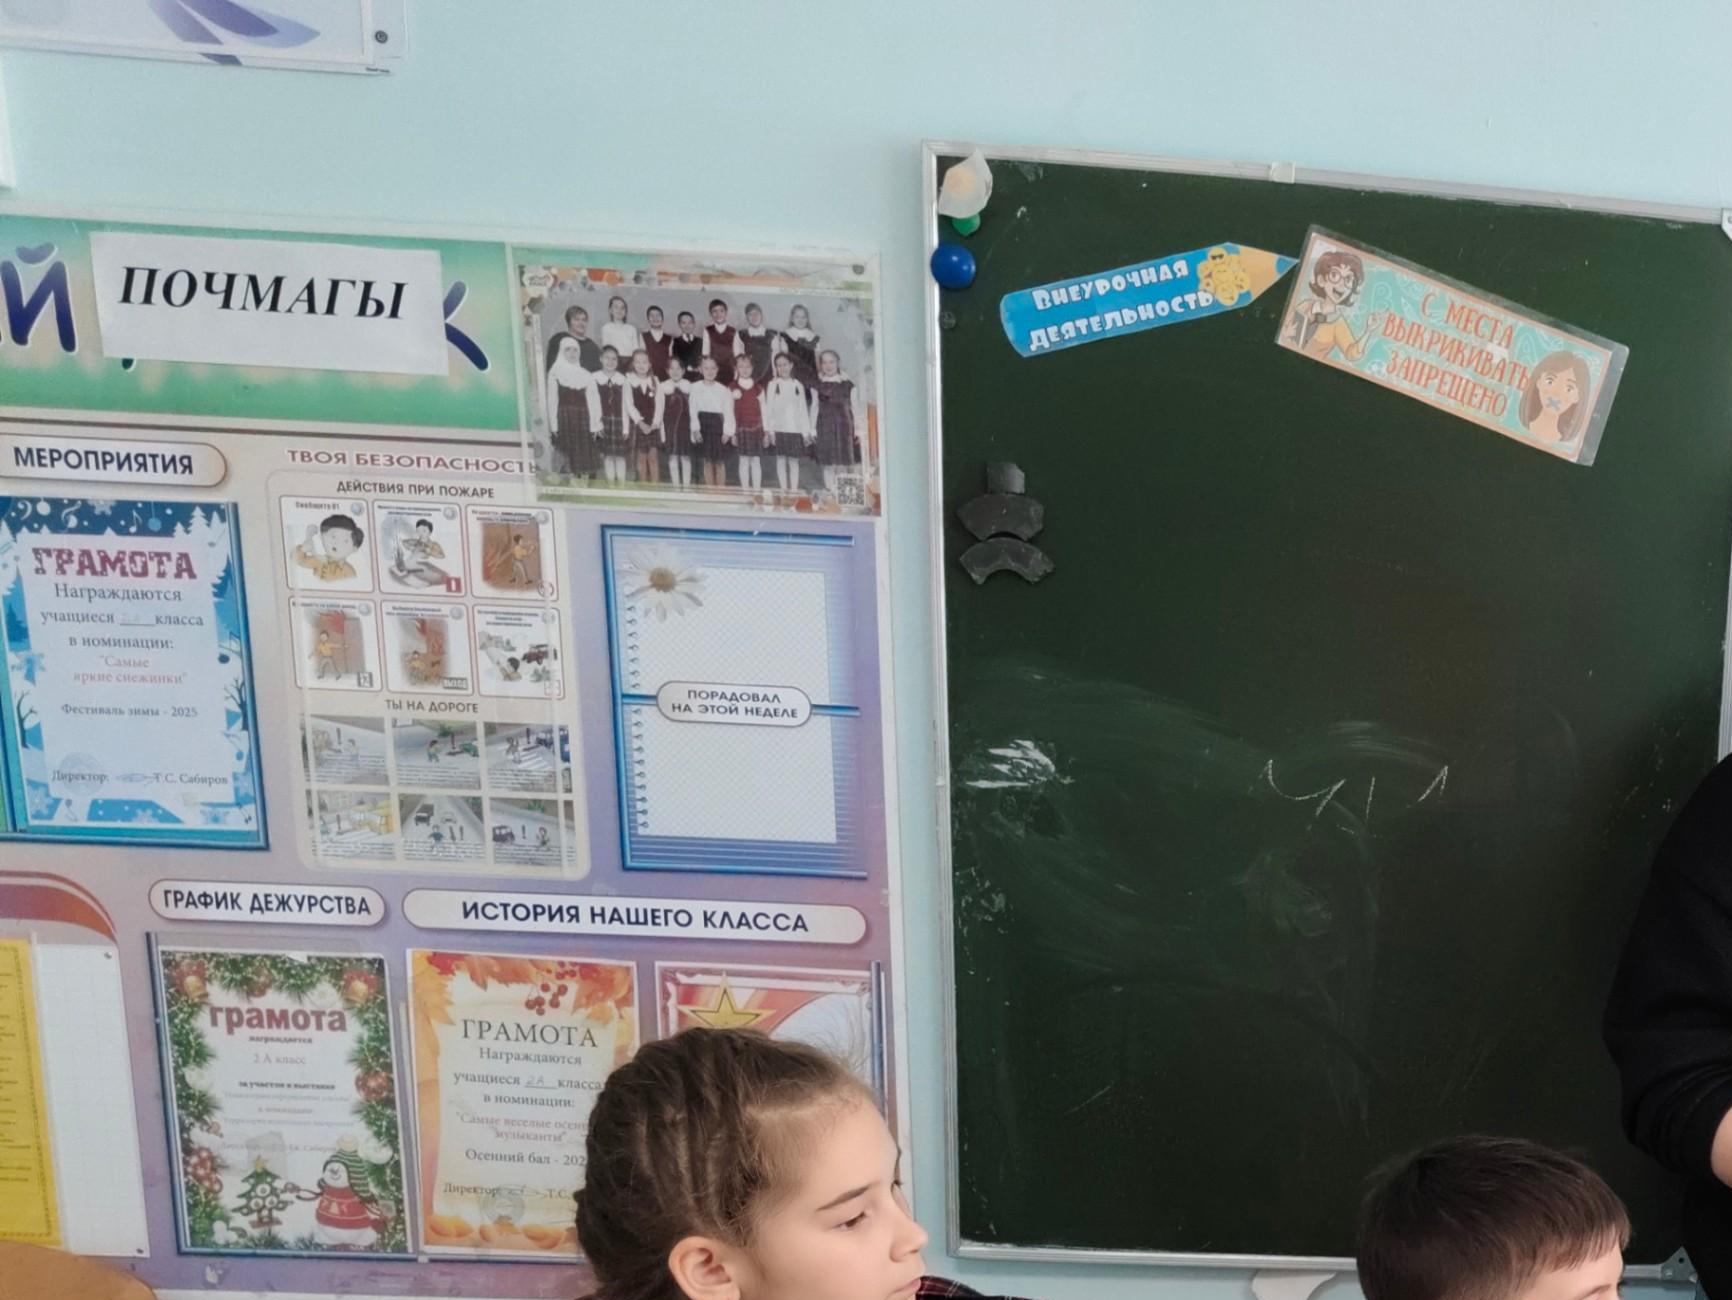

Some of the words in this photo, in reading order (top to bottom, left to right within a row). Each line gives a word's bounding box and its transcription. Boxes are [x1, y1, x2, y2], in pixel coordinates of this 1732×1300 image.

[119, 266, 408, 319] ПОЧМАГЫ
[1029, 290, 1214, 351] ДЕЯТЕЛЬНОСТЬ
[1421, 292, 1437, 317] С
[1445, 302, 1515, 349] МЕСТА
[1382, 312, 1531, 391] ВЫКРИКИВАТЬ
[1386, 350, 1508, 417] ЗАПРЕЩЕНО
[13, 447, 194, 475] МЕРОПРИЯТИЯ
[287, 450, 347, 465] ТВОЯ
[337, 479, 404, 494] ДЕЙСТВИЯ
[409, 484, 435, 496] ПРИ
[440, 485, 495, 498] ПОЖАРЕ
[31, 547, 197, 580] ГРАМОТА
[54, 583, 182, 604] Награждаются
[40, 611, 115, 626] учащиеся
[155, 613, 204, 627] класса
[69, 637, 77, 647] в
[82, 637, 174, 650] номинации:
[101, 653, 150, 669] "Самые
[73, 672, 113, 684] яркие
[116, 672, 188, 685] снежинки"
[687, 690, 781, 703] ПОРАДОВАЛ
[61, 703, 125, 716] Фестиваль
[128, 707, 160, 717] зимы
[171, 707, 198, 718] 2025
[385, 700, 402, 711] ТЫ
[408, 701, 425, 711] НА
[429, 701, 479, 713] ДОРОГЕ
[672, 703, 693, 713] НА
[698, 703, 739, 715] ЭТОЙ
[745, 708, 798, 719] НЕДЕЛЕ
[179, 772, 229, 787] Сабиров
[164, 890, 242, 911] ГРАФИК
[250, 892, 372, 915] ДЕЖУРСТВА
[462, 901, 580, 924] ИСТОРИЯ
[590, 905, 693, 928] НАШЕГО
[703, 910, 809, 932] КЛАССА
[210, 1006, 348, 1036] грамота
[461, 1019, 599, 1048] ГРАМОТА
[479, 1047, 582, 1065] Награждаются
[453, 1072, 521, 1086] учащиеся
[557, 1079, 602, 1091] класса
[483, 1095, 491, 1103] в
[494, 1095, 575, 1109] номинации:
[465, 1149, 525, 1163] Осенний
[528, 1152, 551, 1165] бал
